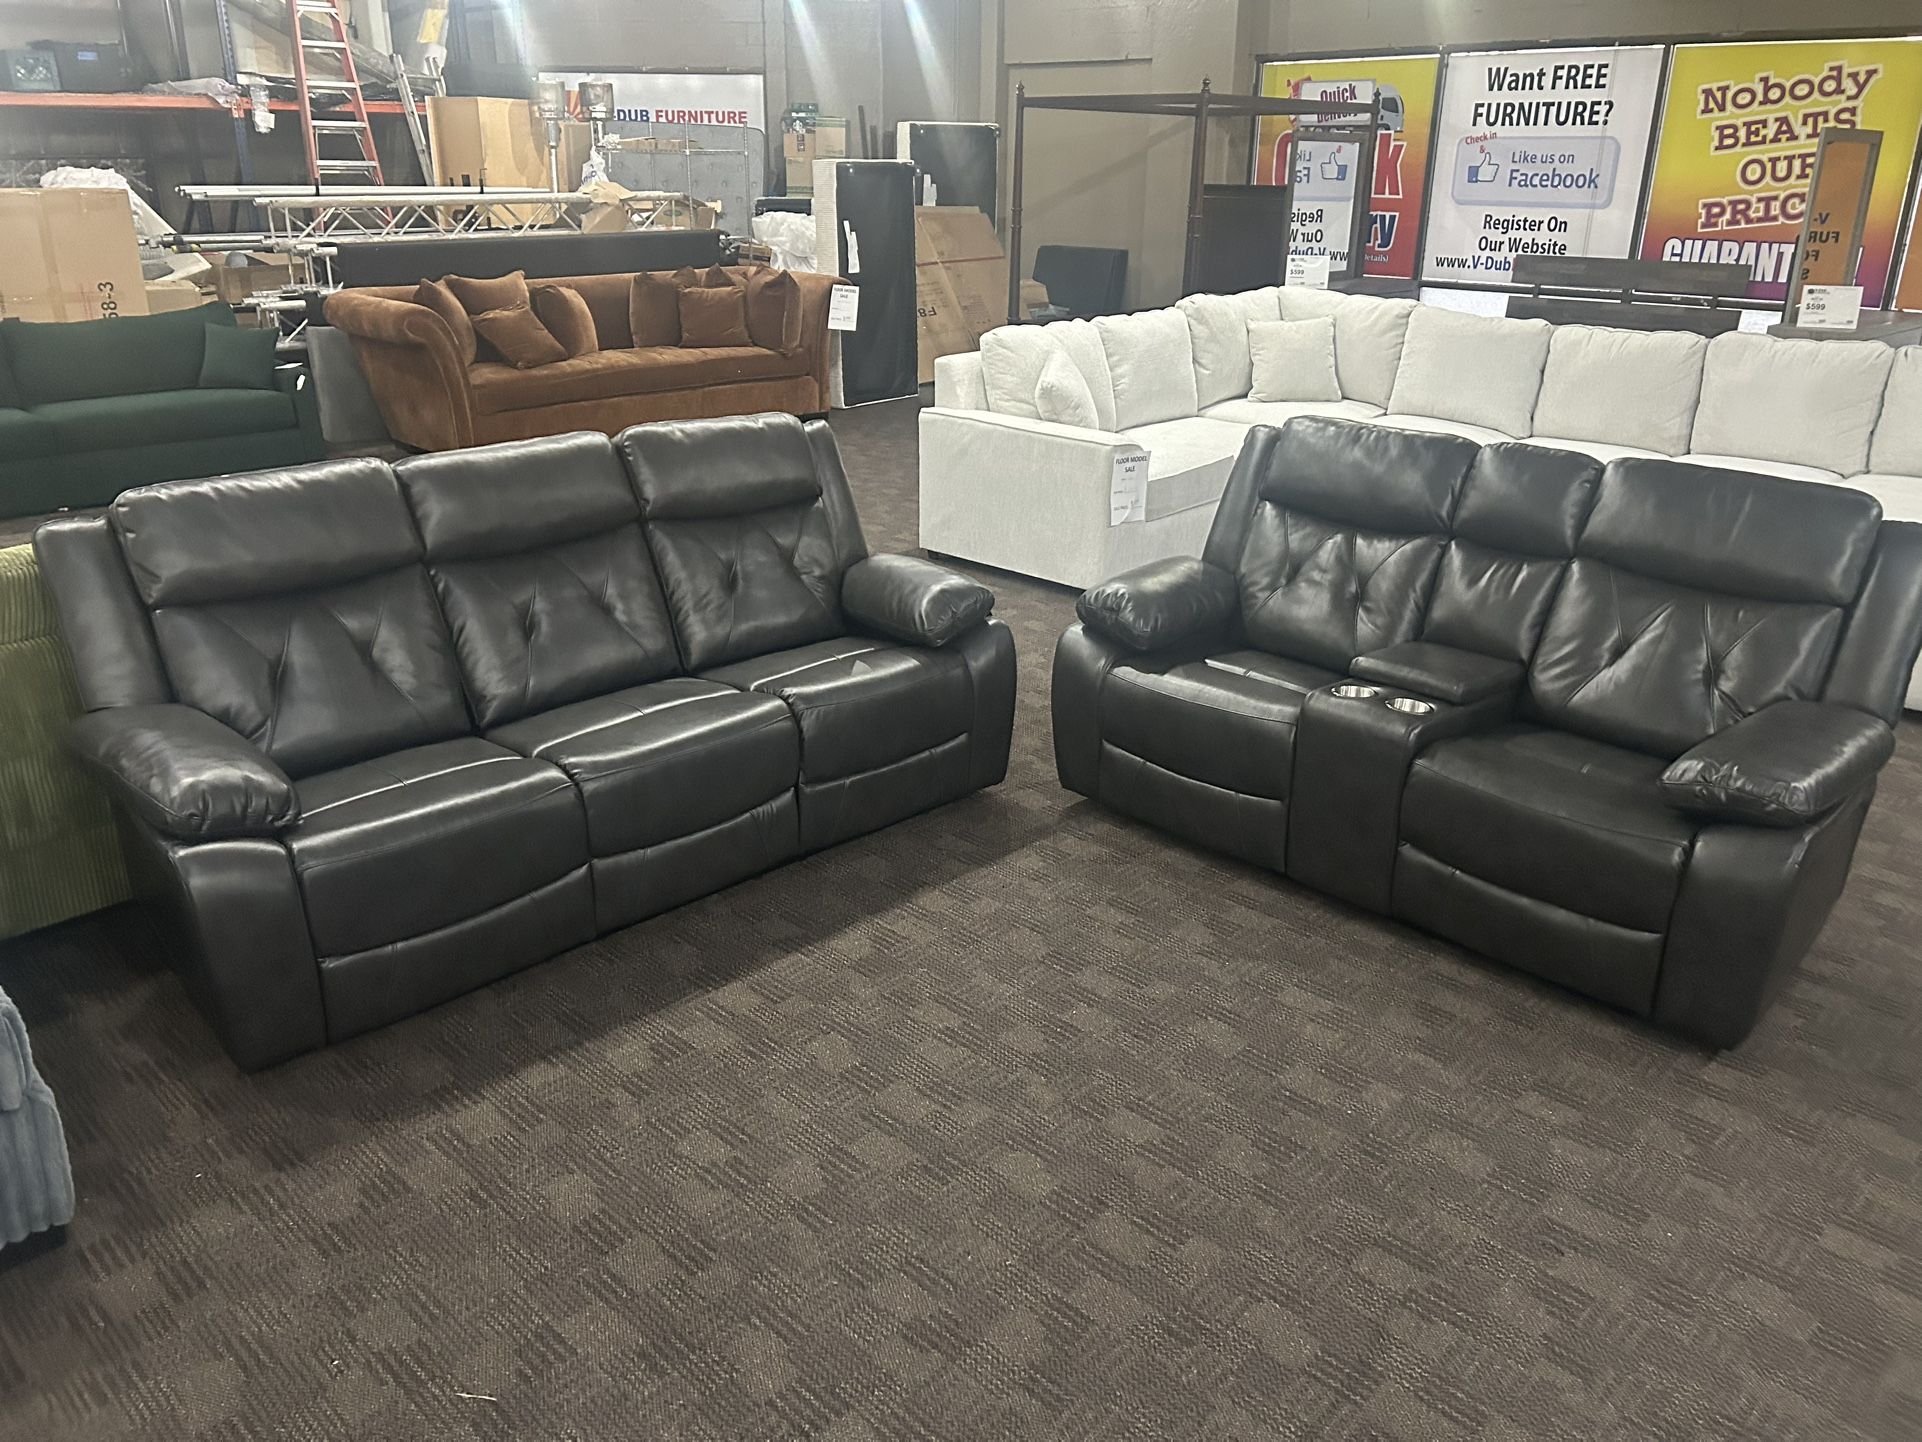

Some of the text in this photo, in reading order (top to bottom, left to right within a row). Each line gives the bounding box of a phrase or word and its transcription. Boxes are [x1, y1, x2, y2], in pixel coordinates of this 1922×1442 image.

[1487, 63, 1610, 92] Want FREE
[1700, 64, 1878, 115] Nobody
[655, 109, 748, 124] FURNITURE
[1471, 100, 1614, 127] FURNITURE?
[1465, 131, 1497, 145] Check in
[1714, 107, 1857, 151] BEATS
[1479, 144, 1485, 153] &
[1511, 151, 1574, 164] Like us on
[1508, 168, 1599, 189] Facebook
[1483, 214, 1568, 234] Register On
[1478, 236, 1567, 256] Our Website
[1435, 255, 1517, 272] www.V-Dub
